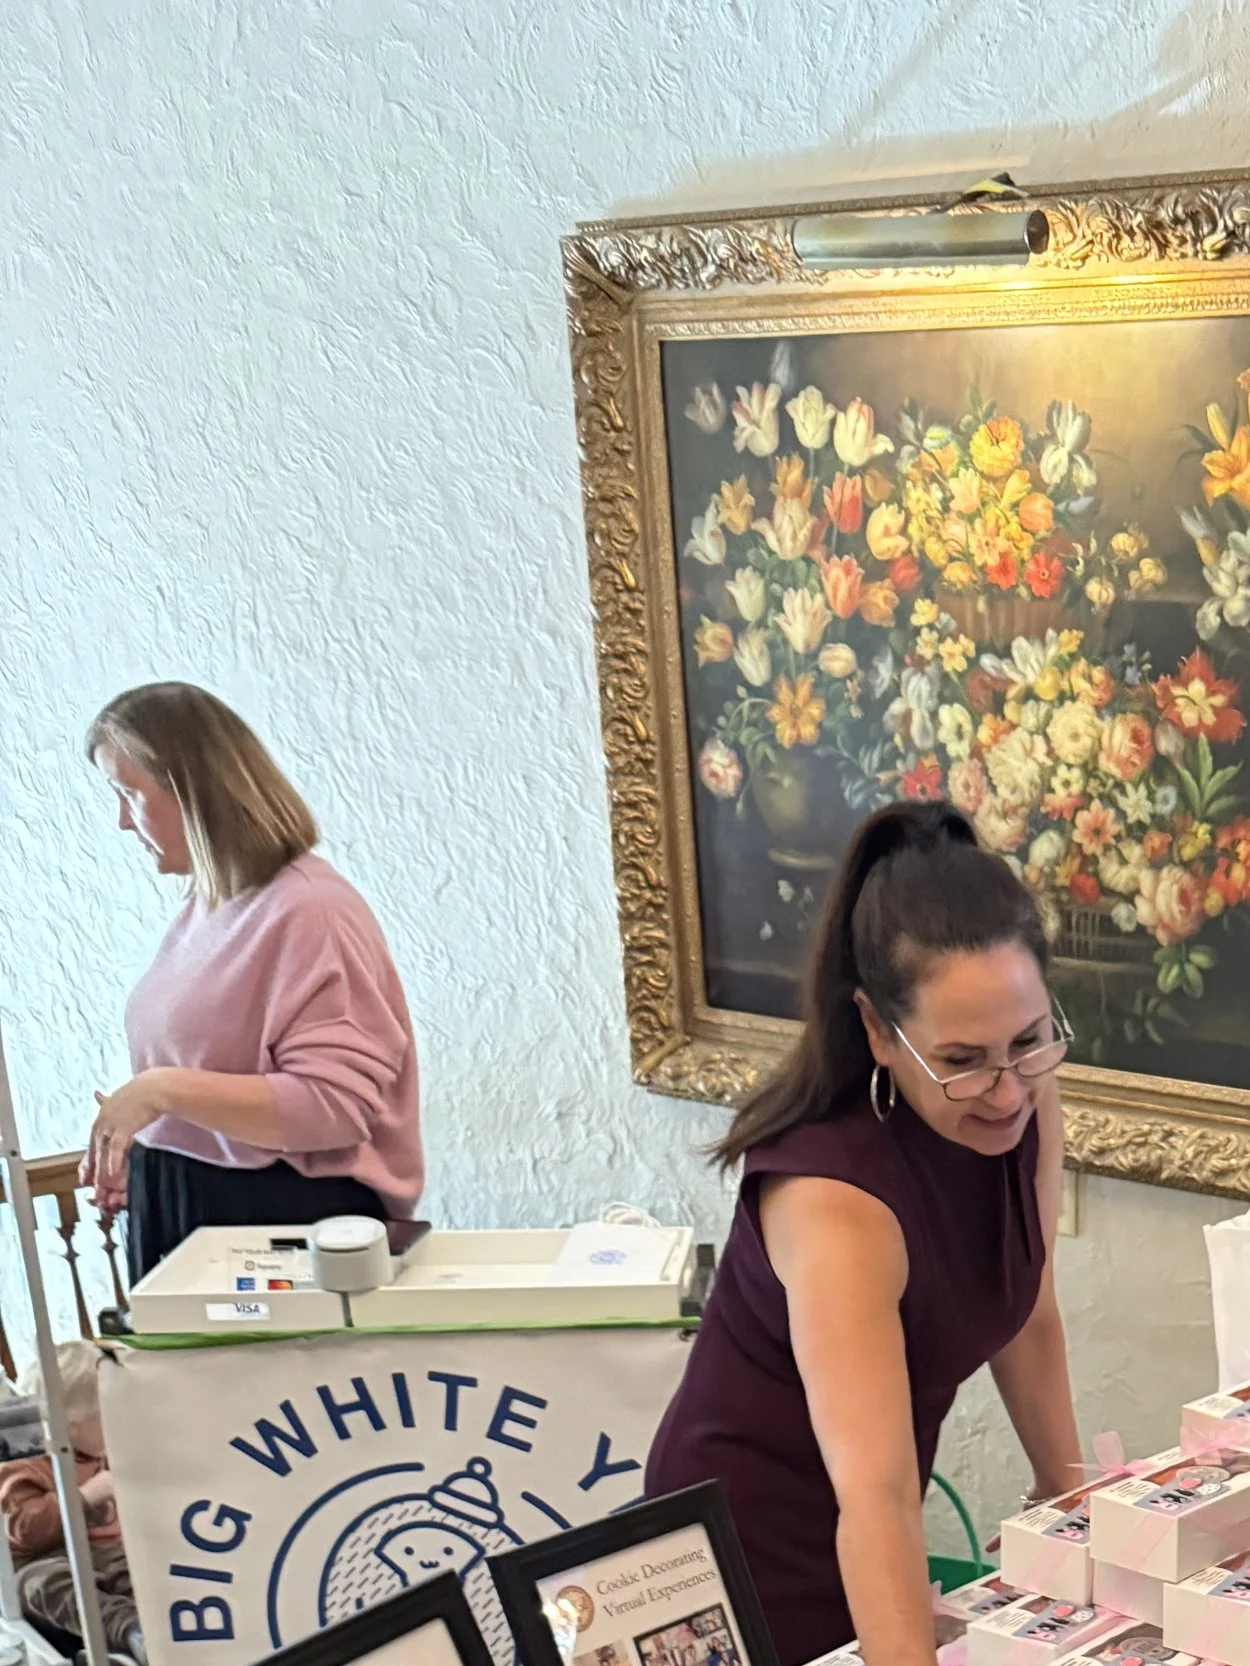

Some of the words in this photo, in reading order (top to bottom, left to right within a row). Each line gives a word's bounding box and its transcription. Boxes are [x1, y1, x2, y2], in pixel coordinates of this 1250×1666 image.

[233, 1302, 261, 1313] VISA
[169, 1499, 252, 1642] BIG
[229, 1370, 548, 1477] WHITE
[596, 1570, 640, 1595] Cookie
[641, 1548, 708, 1580] Decorating
[602, 1591, 647, 1617] Virtual
[647, 1568, 717, 1602] Experiences
